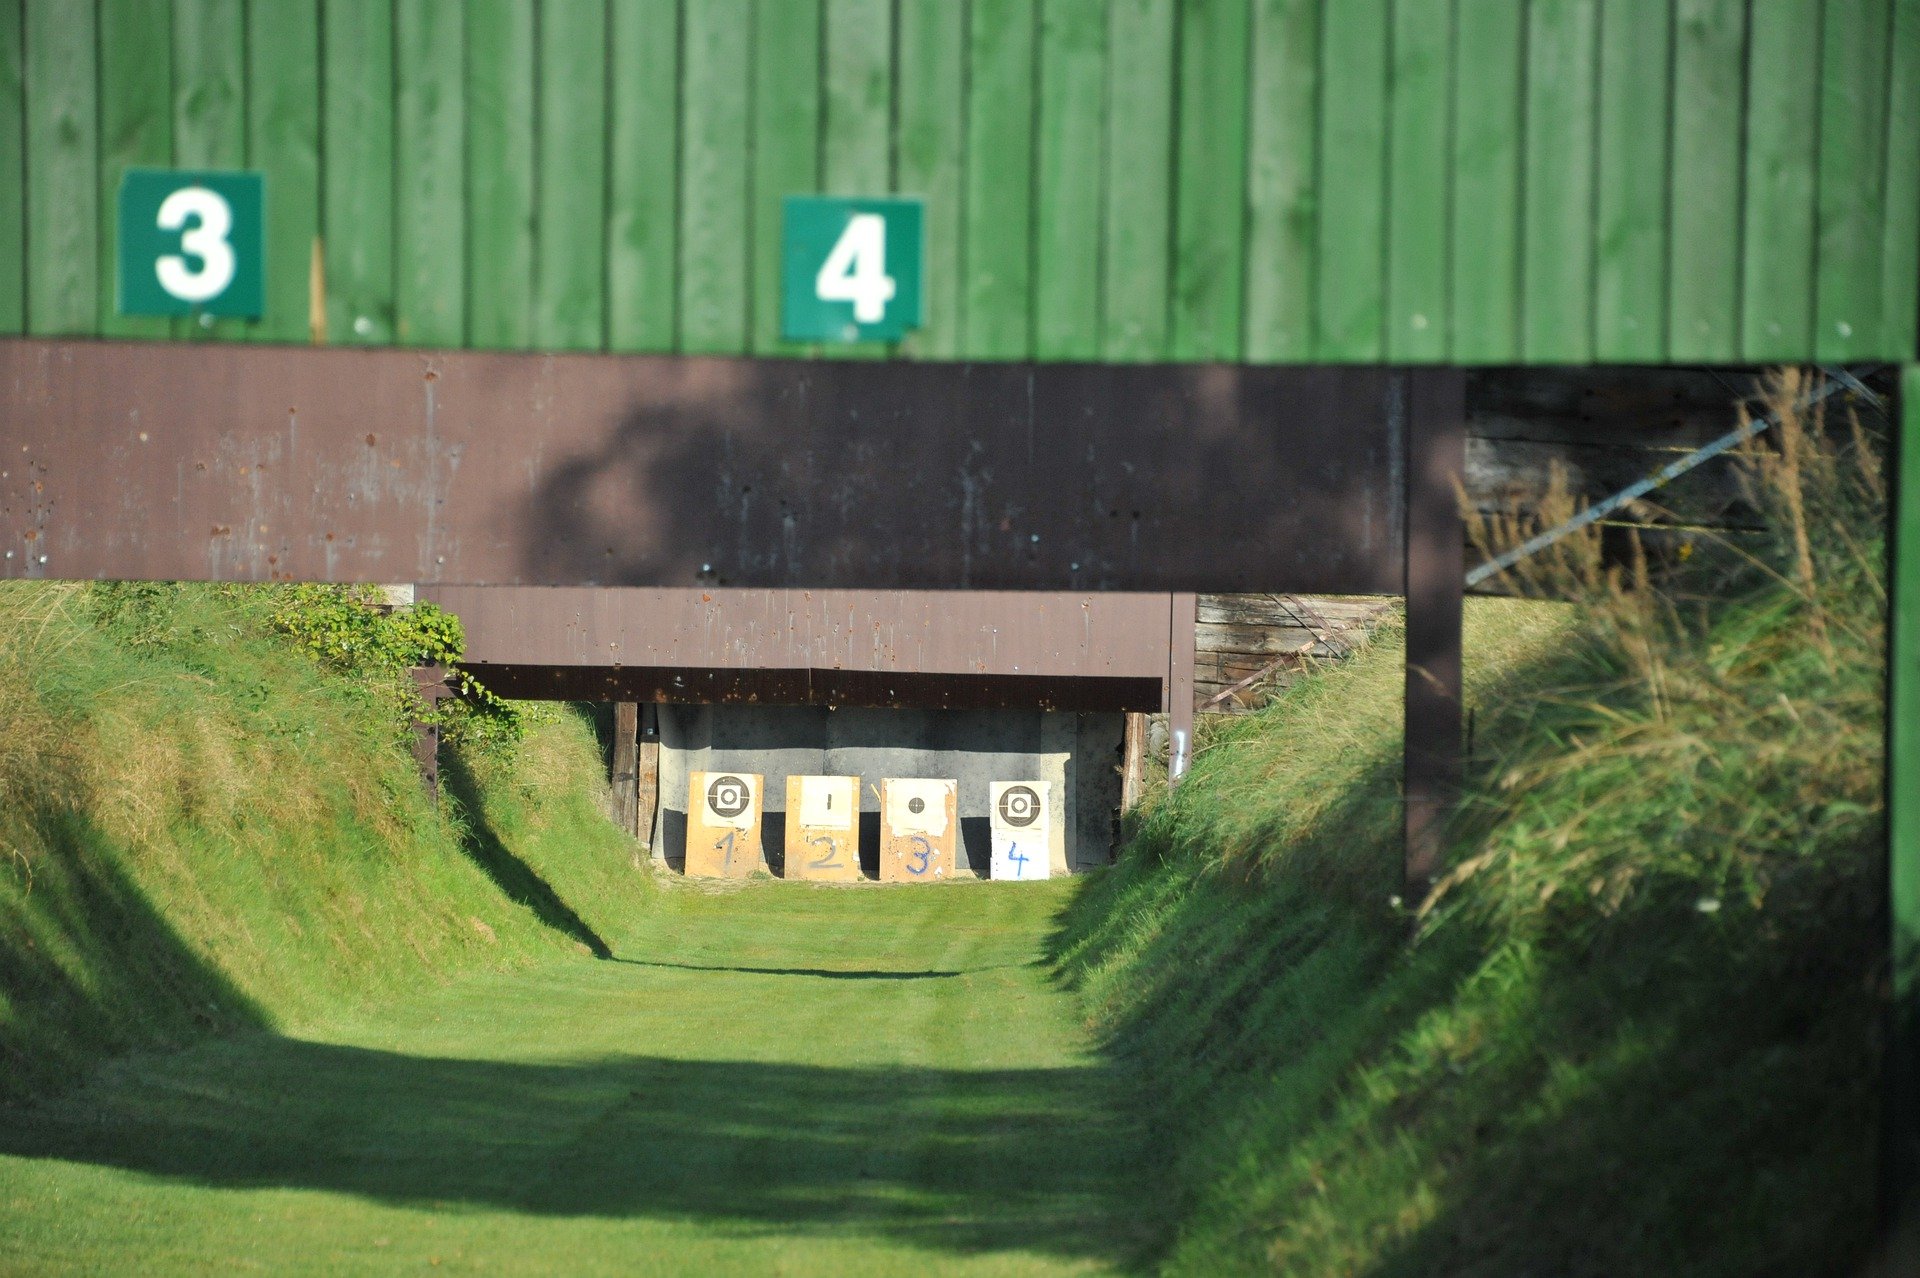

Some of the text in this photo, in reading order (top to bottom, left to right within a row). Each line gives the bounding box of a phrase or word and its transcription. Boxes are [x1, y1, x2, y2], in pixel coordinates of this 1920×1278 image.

[154, 186, 236, 302] 3
[816, 212, 897, 324] 4
[714, 832, 736, 872] 1
[809, 837, 845, 869] 2
[906, 836, 931, 875] 3
[1007, 840, 1030, 876] 4
